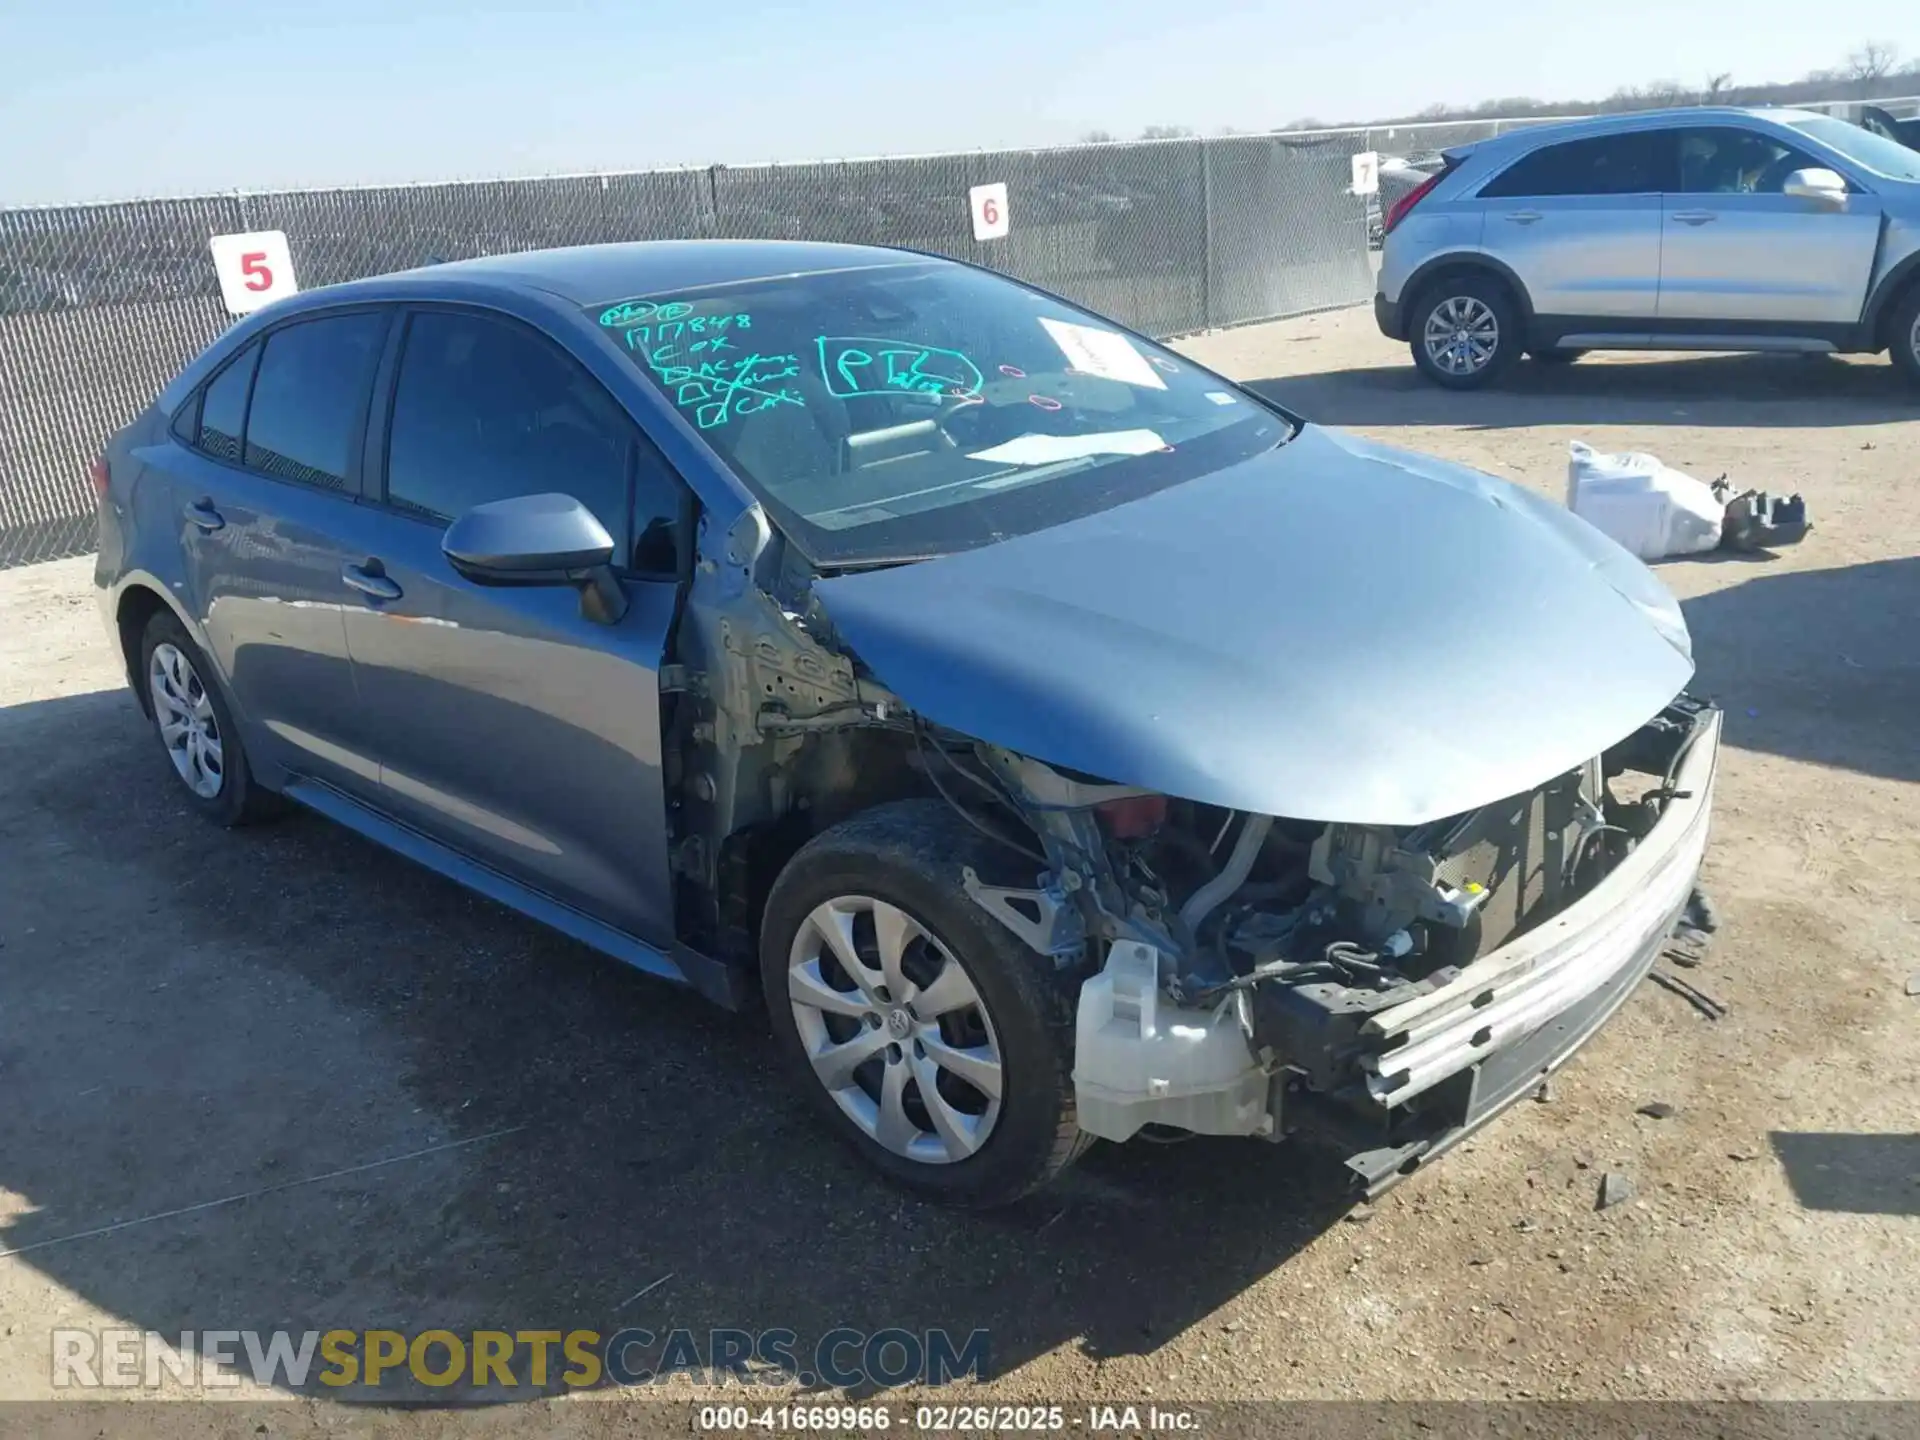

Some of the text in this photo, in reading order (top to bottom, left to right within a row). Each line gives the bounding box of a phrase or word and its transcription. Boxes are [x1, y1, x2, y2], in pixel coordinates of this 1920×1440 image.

[1360, 163, 1370, 185] 7
[983, 198, 999, 225] 6
[241, 252, 273, 292] 5
